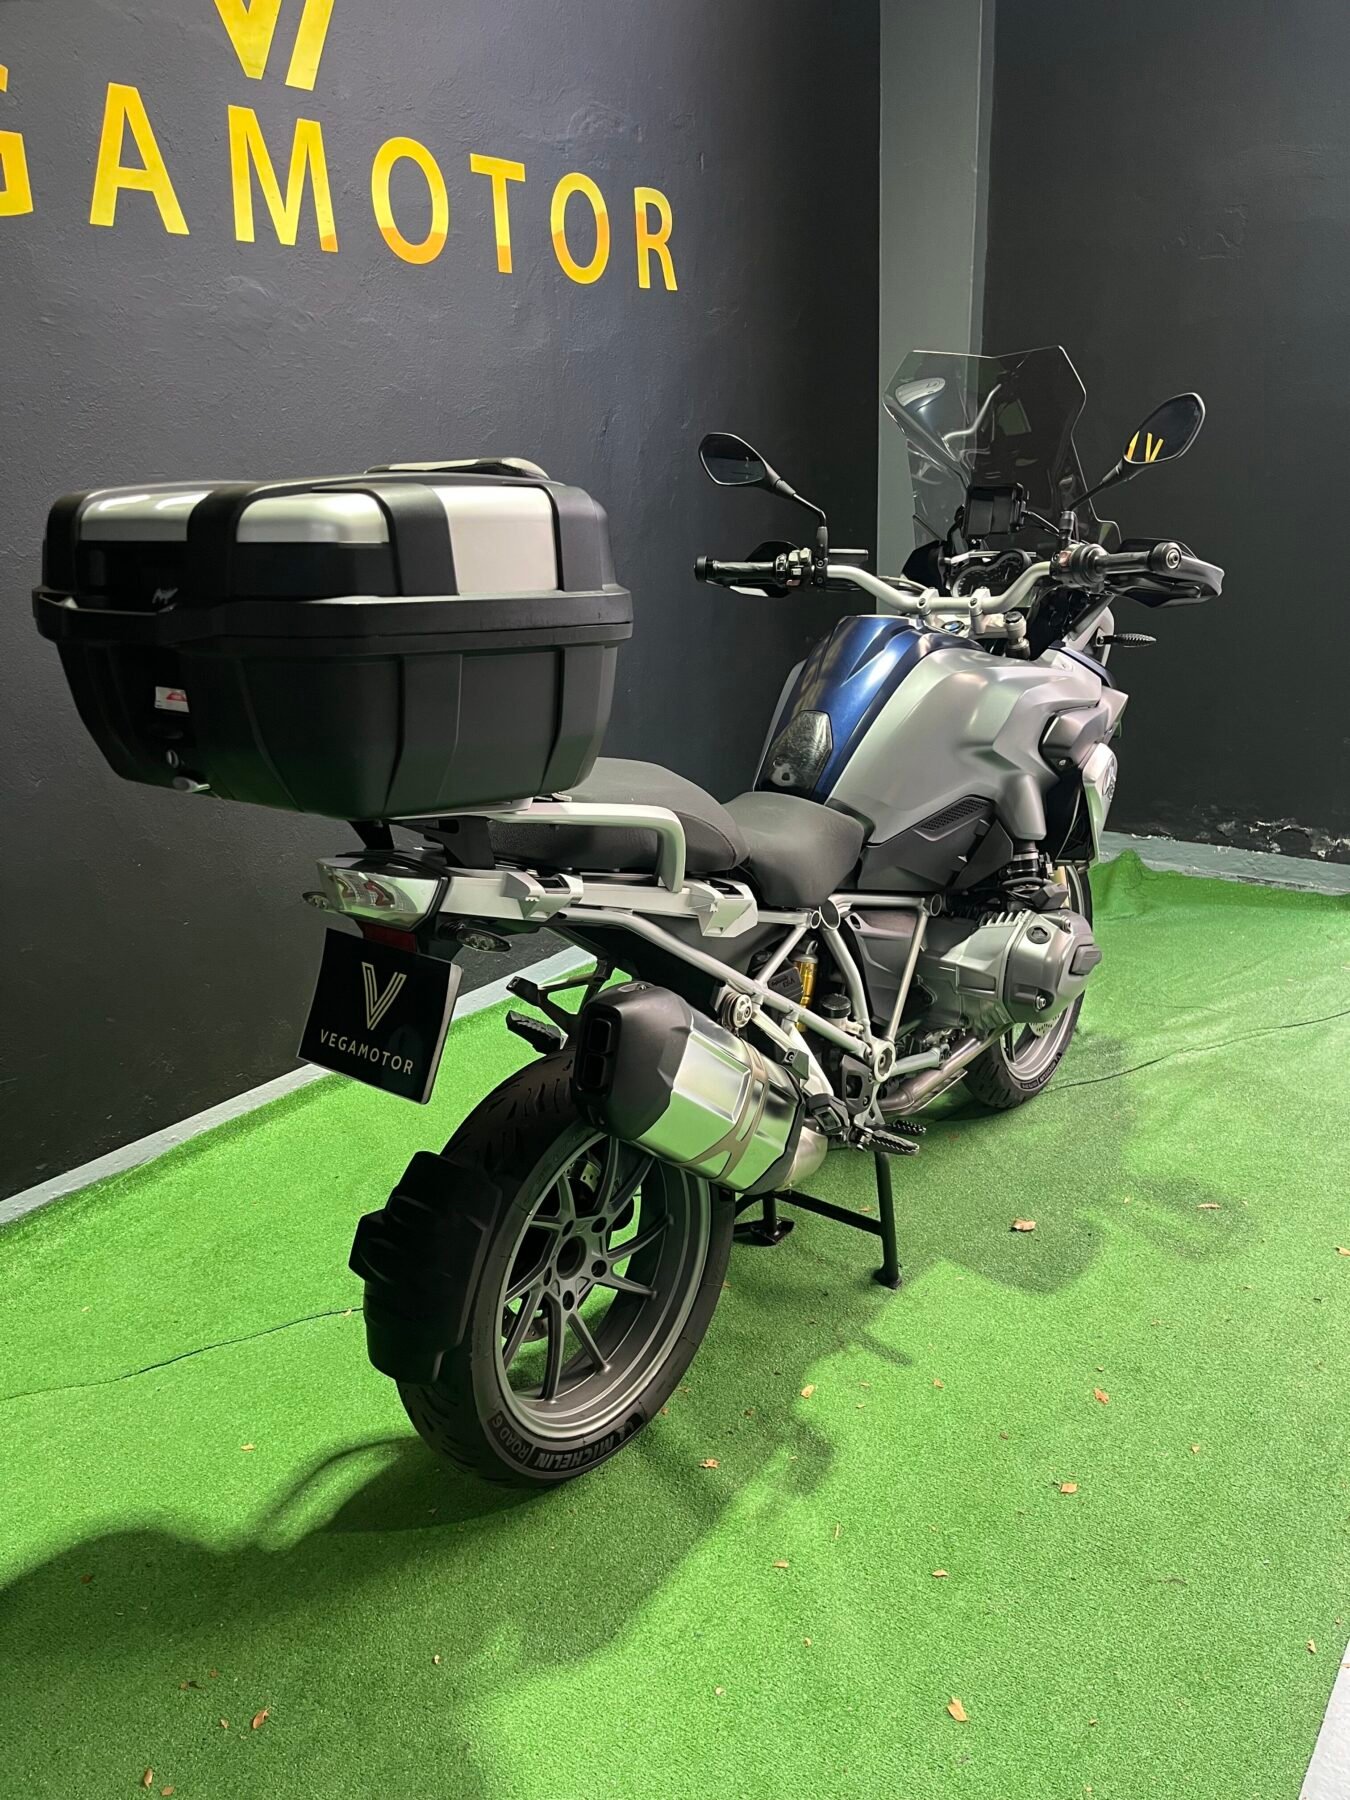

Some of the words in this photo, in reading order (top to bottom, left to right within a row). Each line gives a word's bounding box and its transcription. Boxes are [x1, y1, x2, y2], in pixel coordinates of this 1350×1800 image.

[320, 1029, 414, 1075] VEGAMOTOR
[500, 1428, 530, 1459] ROAD
[534, 1437, 616, 1469] MICHELIN
